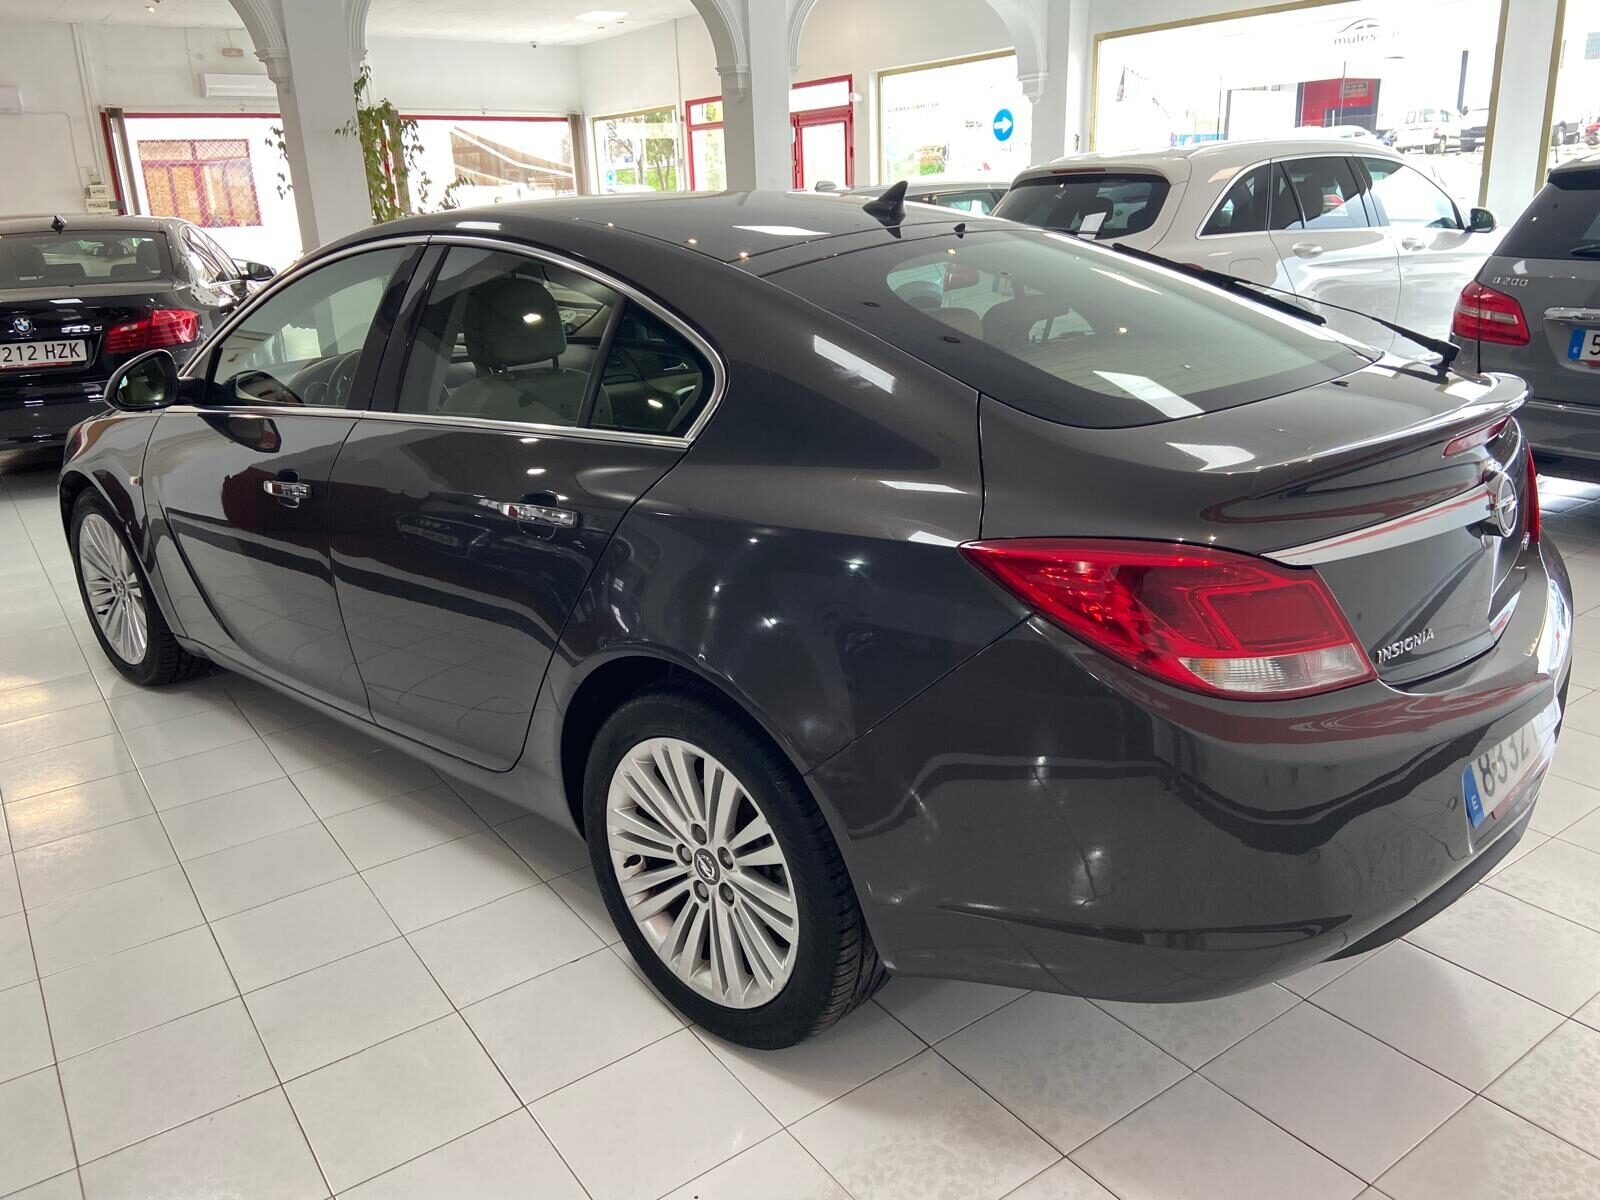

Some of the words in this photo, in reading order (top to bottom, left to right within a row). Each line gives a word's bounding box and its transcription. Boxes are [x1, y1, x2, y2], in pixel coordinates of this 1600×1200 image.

[2, 345, 38, 363] 212
[44, 342, 81, 360] HZK
[1377, 628, 1435, 664] INSIGNIA
[1470, 794, 1479, 811] E
